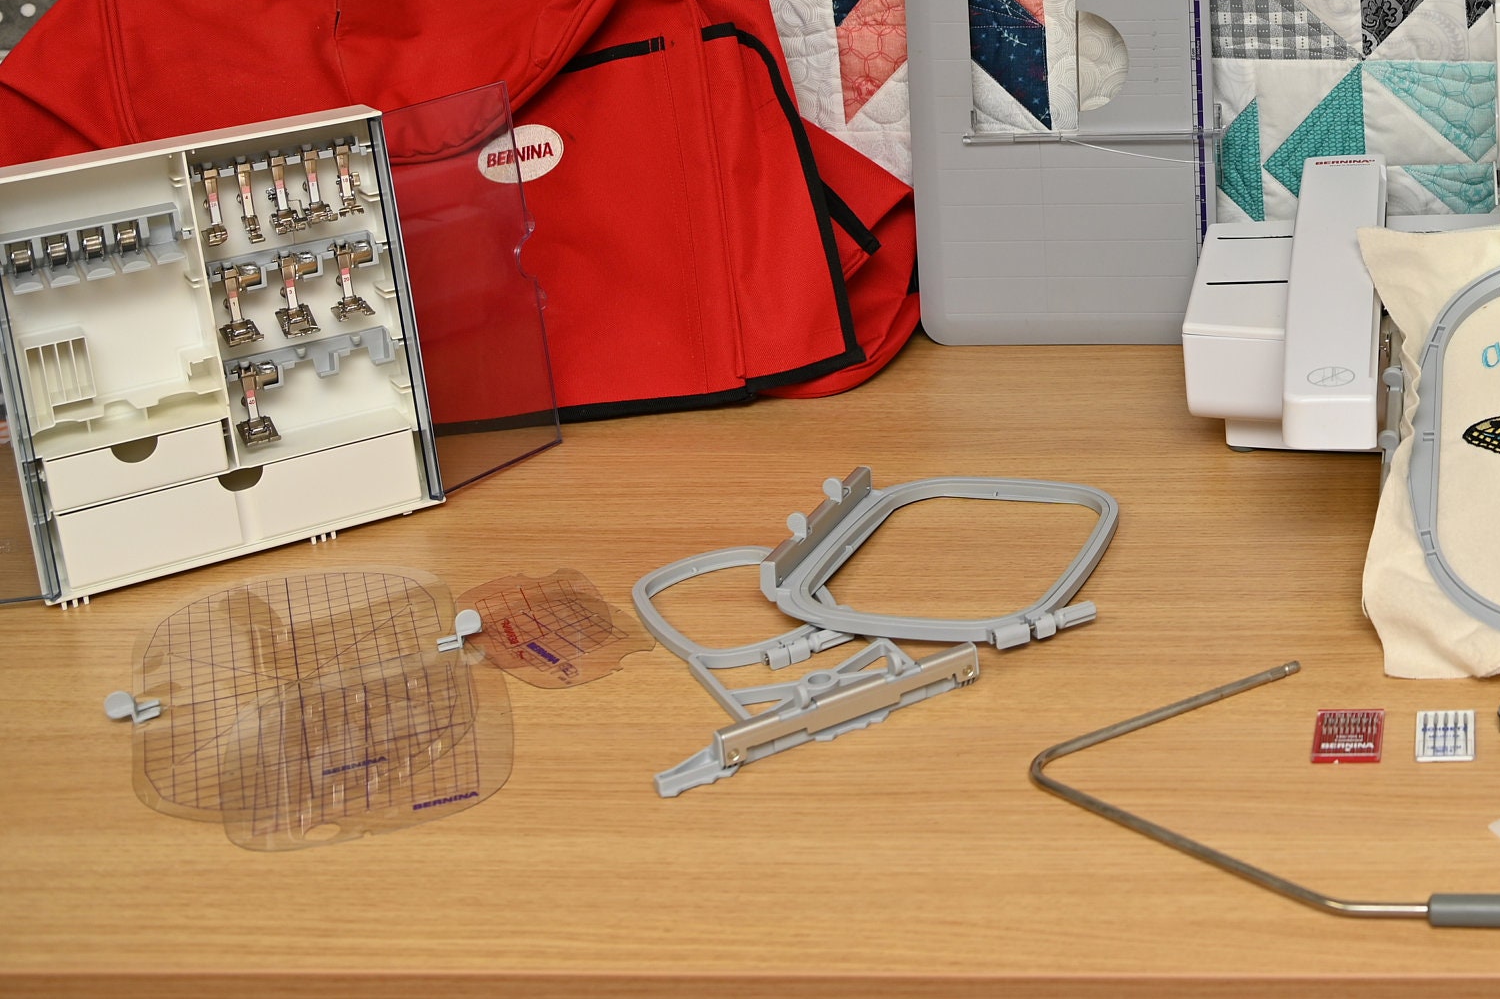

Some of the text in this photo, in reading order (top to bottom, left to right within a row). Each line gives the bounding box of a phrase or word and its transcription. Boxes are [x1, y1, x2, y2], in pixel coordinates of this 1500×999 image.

[487, 142, 554, 168] BERNINA
[1320, 741, 1375, 750] BERNINA
[322, 756, 388, 776] BERNINA
[413, 791, 479, 811] BERNINA
